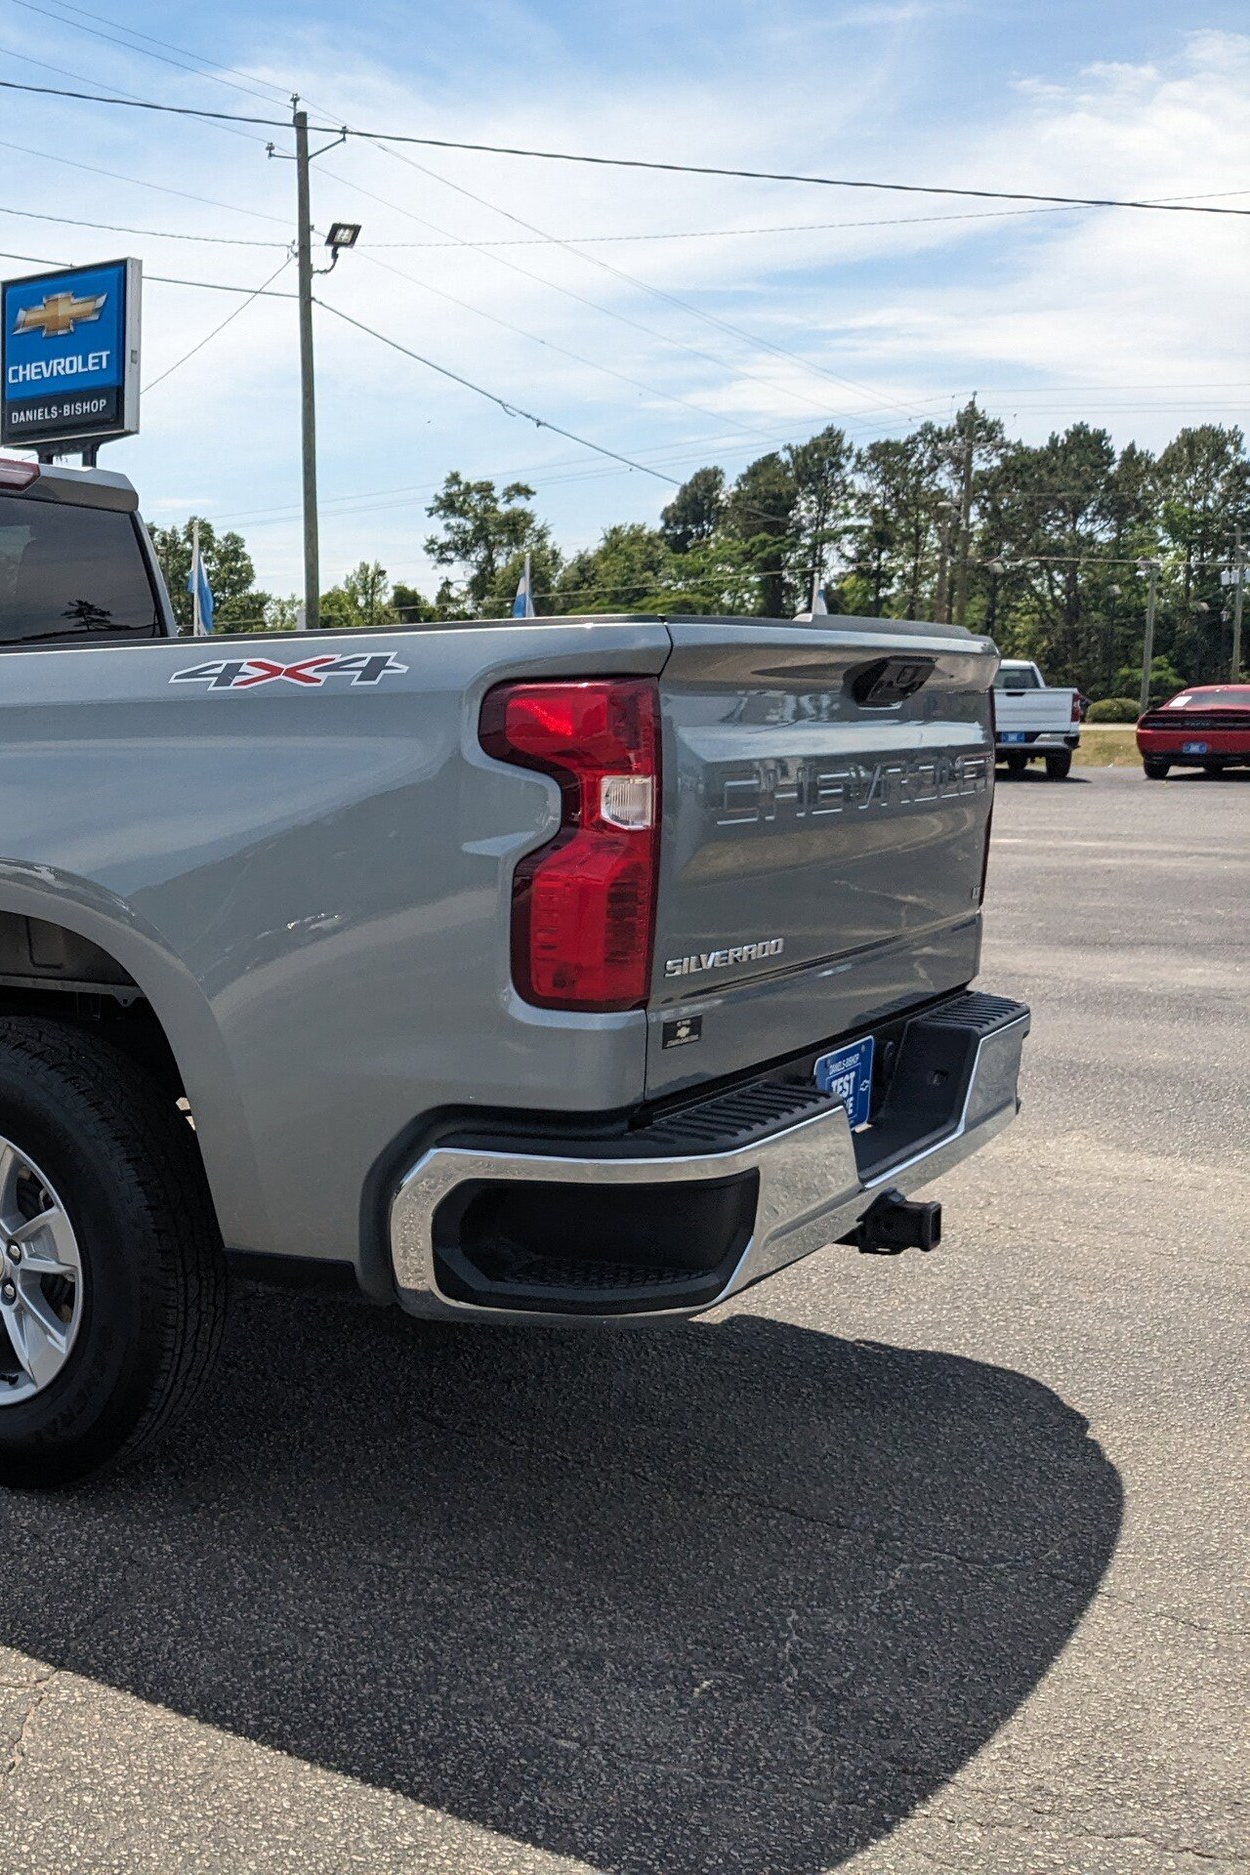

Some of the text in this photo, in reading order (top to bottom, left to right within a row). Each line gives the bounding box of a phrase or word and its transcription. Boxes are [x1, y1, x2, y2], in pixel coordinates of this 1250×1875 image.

[8, 351, 110, 383] CHEVROLET
[11, 399, 107, 424] DANIELS-BISHOP
[168, 651, 410, 691] 4X4
[664, 938, 784, 977] SILVERADO
[831, 1070, 856, 1098] TEST
